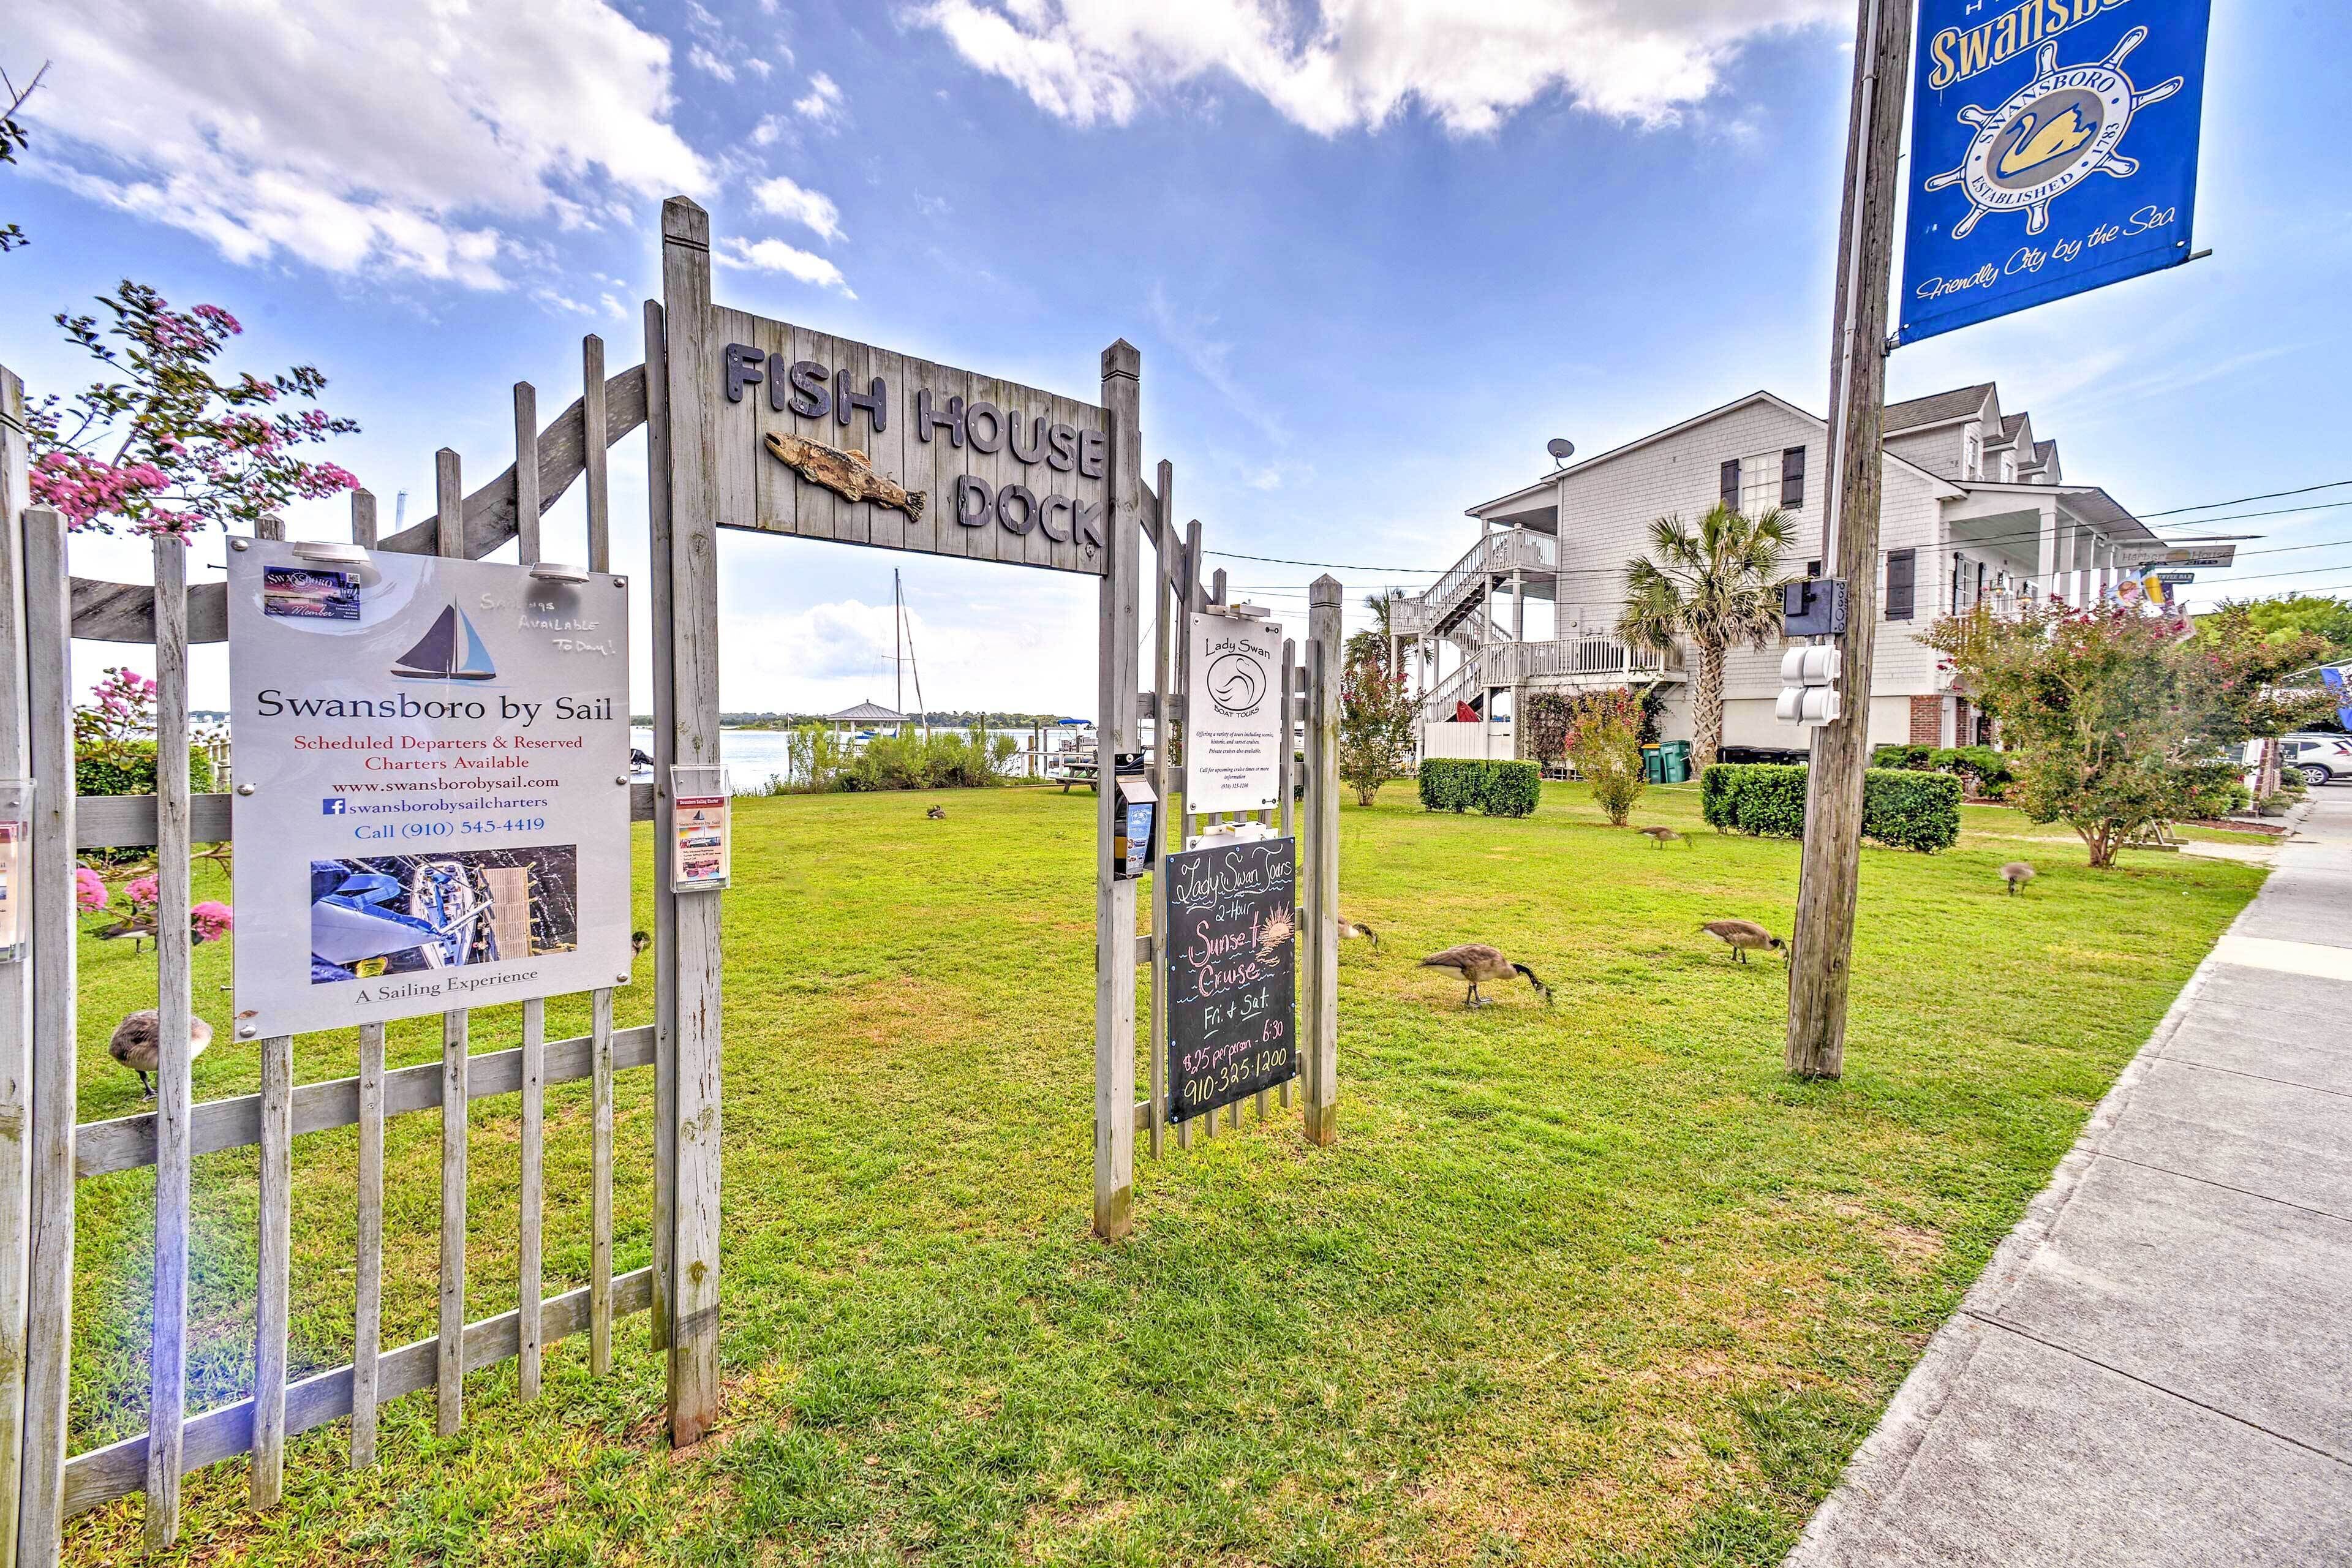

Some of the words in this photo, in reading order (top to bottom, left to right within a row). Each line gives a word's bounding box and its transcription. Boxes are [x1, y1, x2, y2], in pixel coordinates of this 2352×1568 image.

[1930, 0, 2132, 89] Swans
[1979, 71, 2116, 144] SWANSBORO
[2092, 123, 2119, 154] 1783
[1972, 173, 2074, 205] ESTABLISHED
[1916, 263, 1999, 300] Friendly
[2004, 247, 2047, 273] City
[2051, 238, 2082, 262] by
[2087, 223, 2119, 247] the
[2122, 205, 2176, 236] Sea
[726, 343, 887, 432] FISH
[918, 387, 1106, 480] HOUSE
[957, 473, 1103, 548] DOCK
[292, 605, 334, 617] Member
[1205, 638, 1235, 657] Lady
[1238, 639, 1270, 659] Swan
[258, 690, 485, 719] Swansboro
[499, 695, 542, 727] by
[556, 696, 614, 721] Sail
[1214, 704, 1234, 717] BOAT
[1236, 707, 1259, 718] TOURS
[294, 736, 393, 750] Scheduled
[401, 736, 487, 753] Departers
[492, 736, 509, 749] &
[514, 736, 583, 749] Reserved
[364, 757, 447, 771] Charters
[453, 756, 529, 769] Available
[332, 776, 559, 793] www.swansborobysail.com
[349, 797, 548, 815] swansborobysailcharters
[355, 823, 394, 840] Call
[402, 821, 454, 839] (910)
[461, 818, 545, 834] 545-4419
[1177, 858, 1218, 911] Lady
[1221, 852, 1258, 892] Swan
[1251, 844, 1292, 894] Tours
[1216, 900, 1254, 921] 2-Hour
[1188, 911, 1261, 967] Sunset
[355, 990, 371, 1004] A
[379, 983, 441, 1000] Sailing
[447, 971, 538, 991] Experience
[1199, 962, 1260, 997] Cruise
[1183, 1047, 1210, 1074] $25
[1213, 1045, 1227, 1069] per
[1262, 1019, 1284, 1042] 6:30
